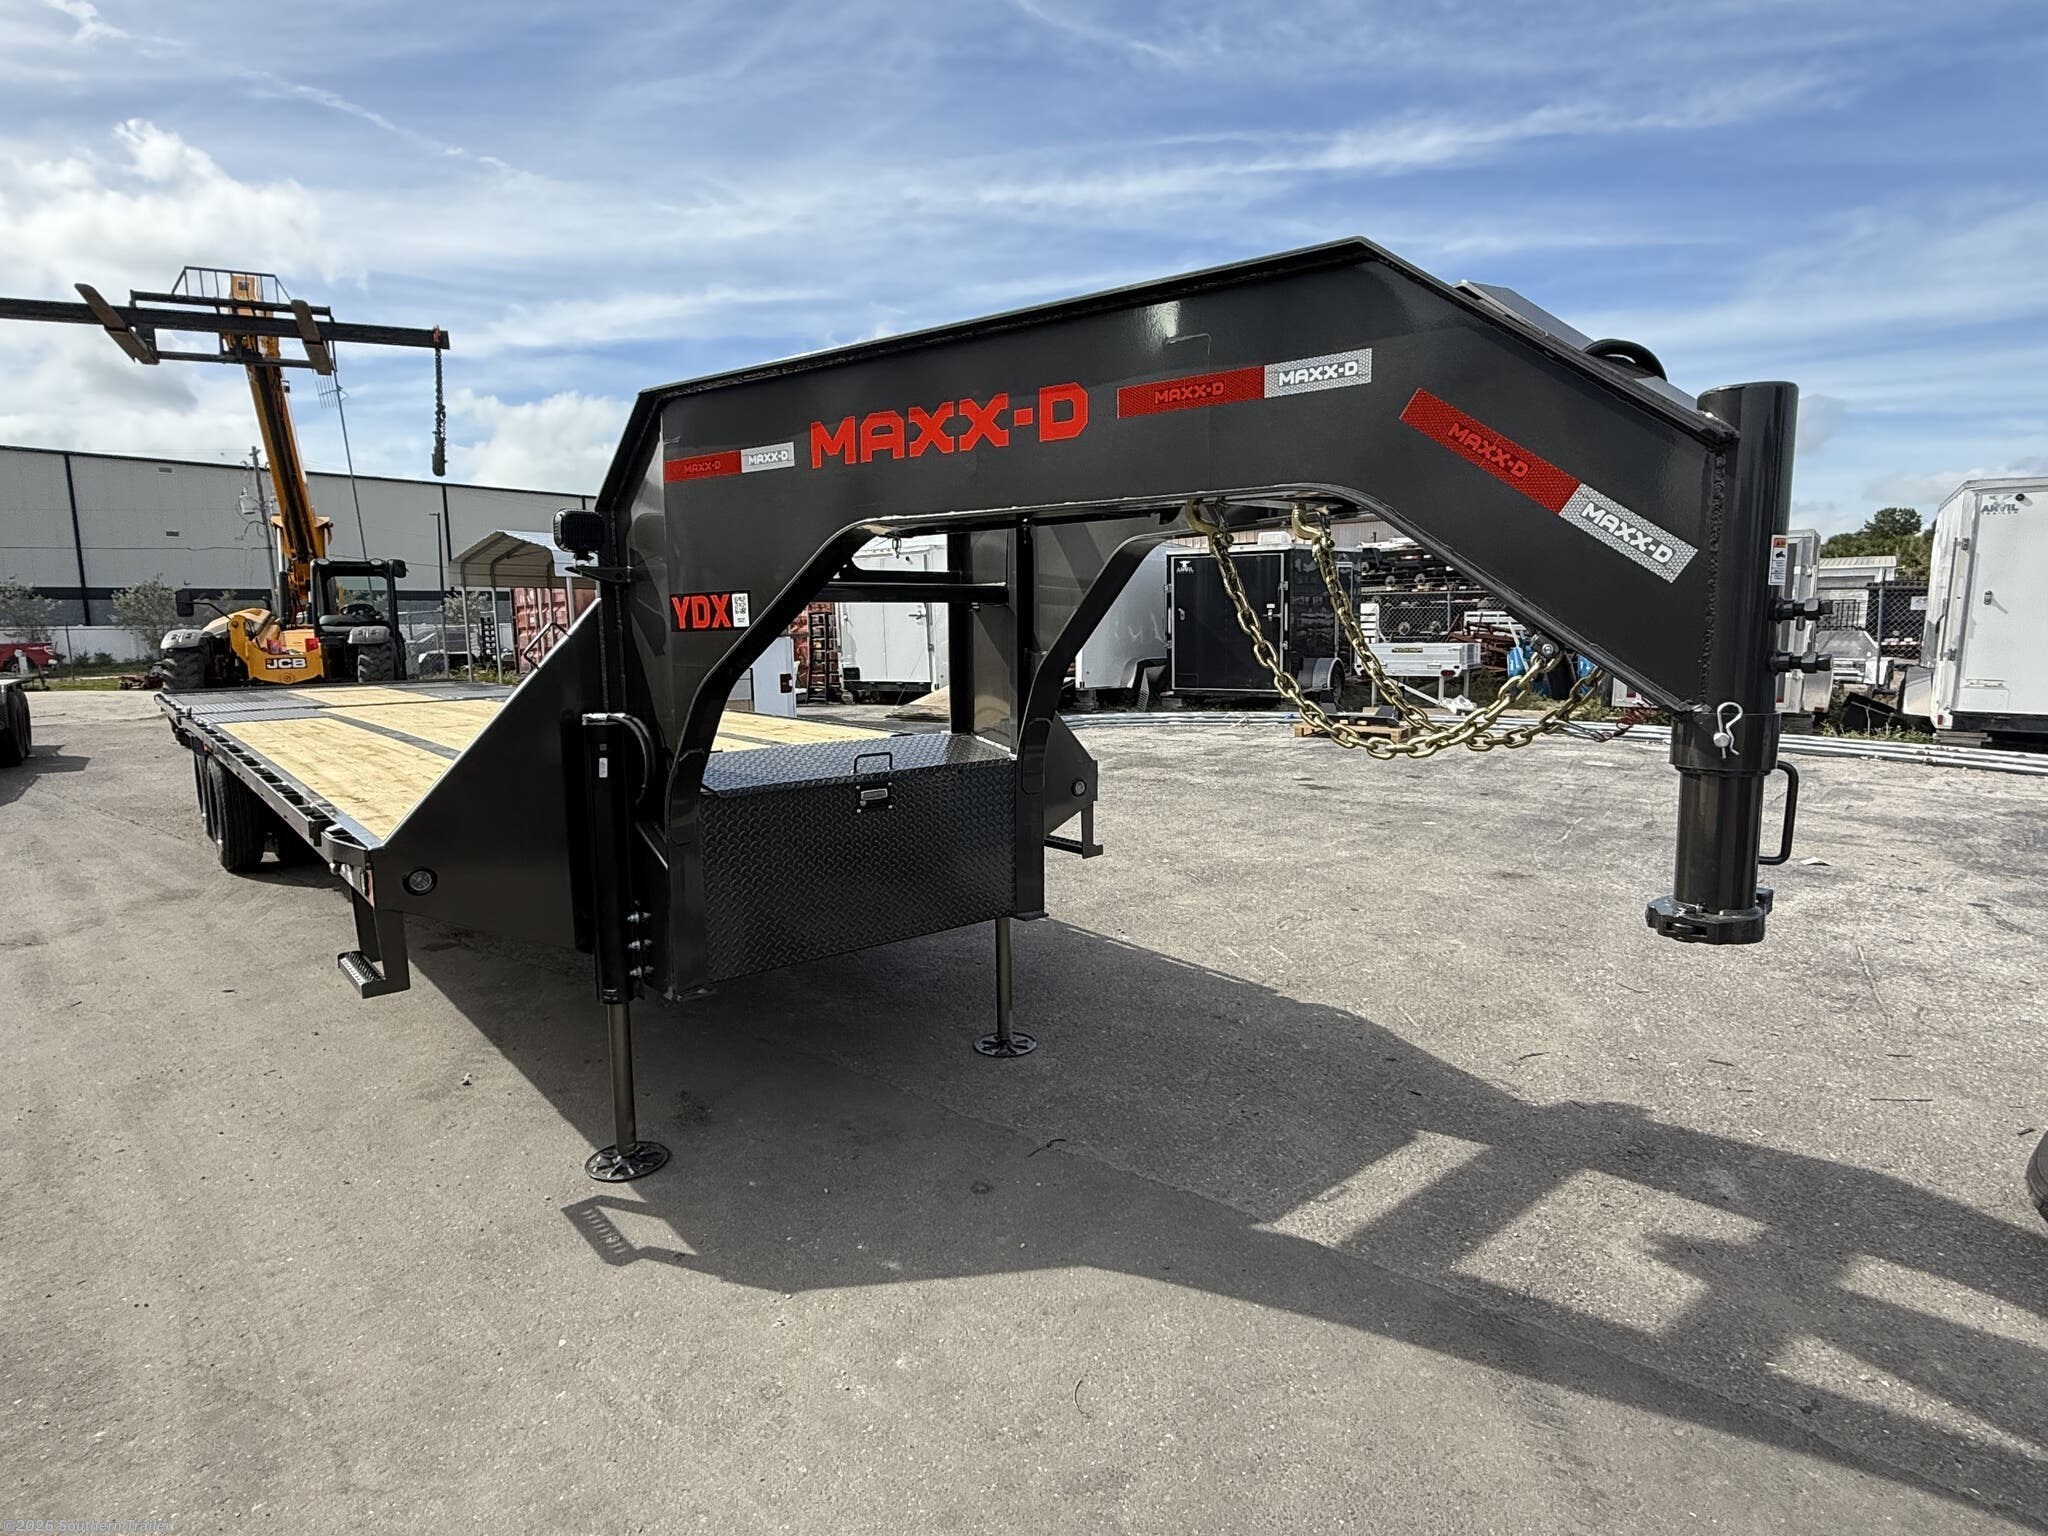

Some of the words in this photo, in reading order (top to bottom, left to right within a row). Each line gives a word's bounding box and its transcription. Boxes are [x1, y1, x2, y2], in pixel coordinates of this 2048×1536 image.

[1278, 361, 1359, 388] MAXX-D
[1154, 380, 1225, 404] MAXX-D
[811, 382, 1088, 469] MAXX-D
[748, 450, 789, 466] MAXX-D
[1448, 422, 1530, 479] MAXX-D
[684, 460, 722, 474] MAXX-D
[1581, 502, 1673, 564] MAXX-D
[671, 594, 732, 630] YDX
[266, 658, 307, 669] JCB
